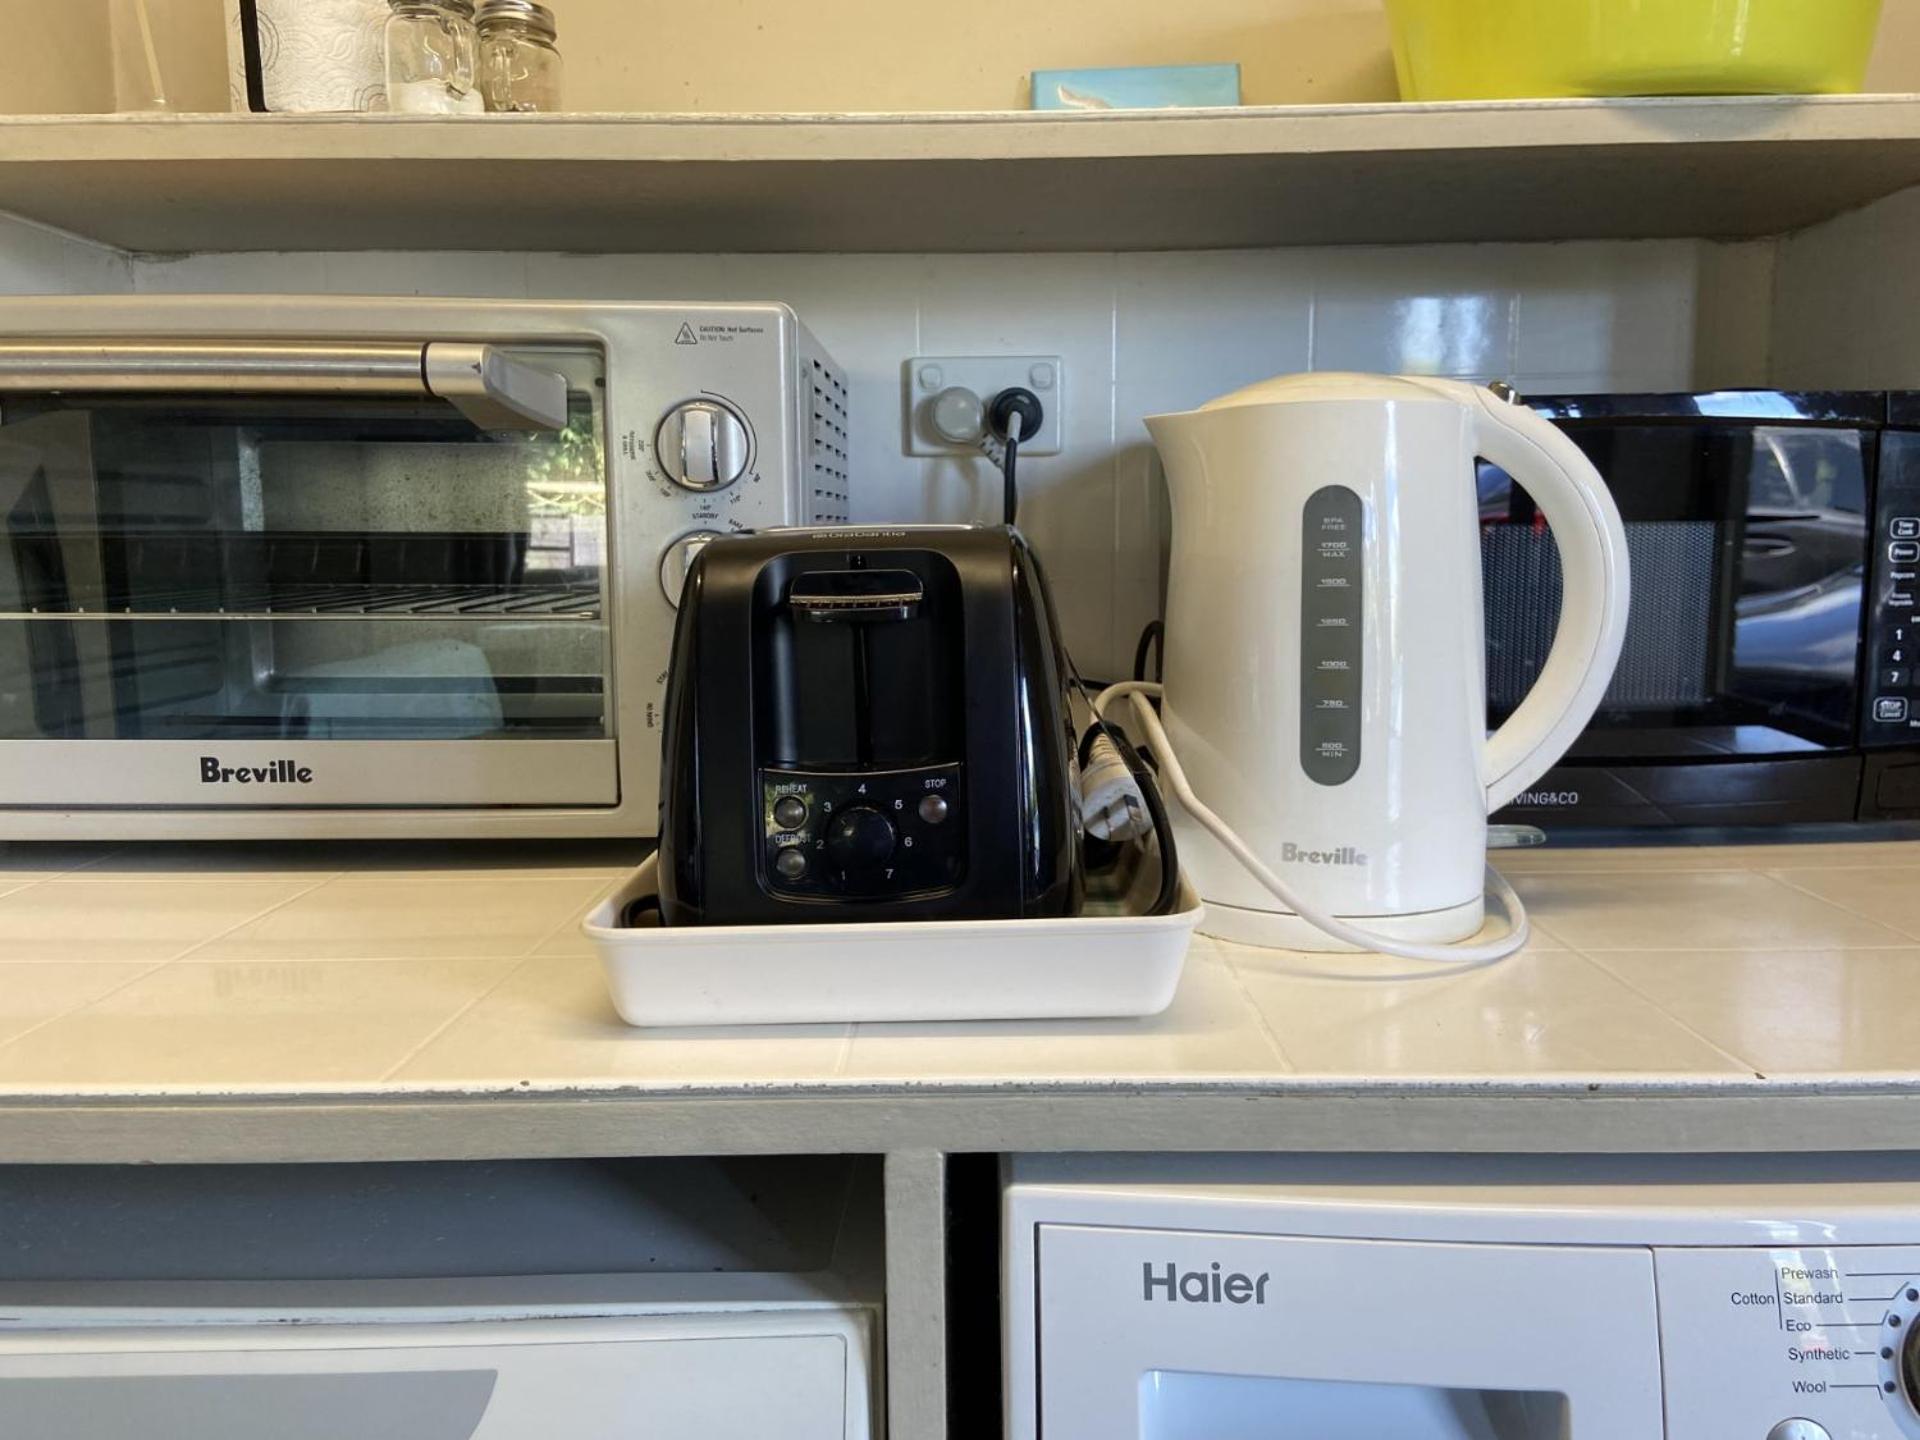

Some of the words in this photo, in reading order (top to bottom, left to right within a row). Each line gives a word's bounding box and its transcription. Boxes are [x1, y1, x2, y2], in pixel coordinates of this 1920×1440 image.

[1896, 628, 1903, 640] 1
[1892, 649, 1901, 661] 4
[1891, 671, 1900, 683] 7
[200, 756, 313, 783] Breville
[775, 783, 807, 794] REHEAT
[858, 784, 866, 794] 4
[924, 778, 947, 789] STOP
[1510, 792, 1579, 805] VING&CO
[823, 802, 832, 812] 3
[894, 800, 903, 810] 5
[816, 840, 825, 850] 2
[904, 837, 913, 847] 6
[1281, 842, 1368, 866] Breville
[841, 871, 846, 880] 1
[886, 868, 895, 879] 7
[1781, 1267, 1839, 1279] Prewash
[1143, 1261, 1269, 1304] Haier
[1731, 1292, 1775, 1305] Cotton
[1783, 1291, 1843, 1304] Standard
[1786, 1319, 1812, 1332] Eco
[1788, 1347, 1851, 1364] Synthetic
[1792, 1380, 1827, 1393] Wool
